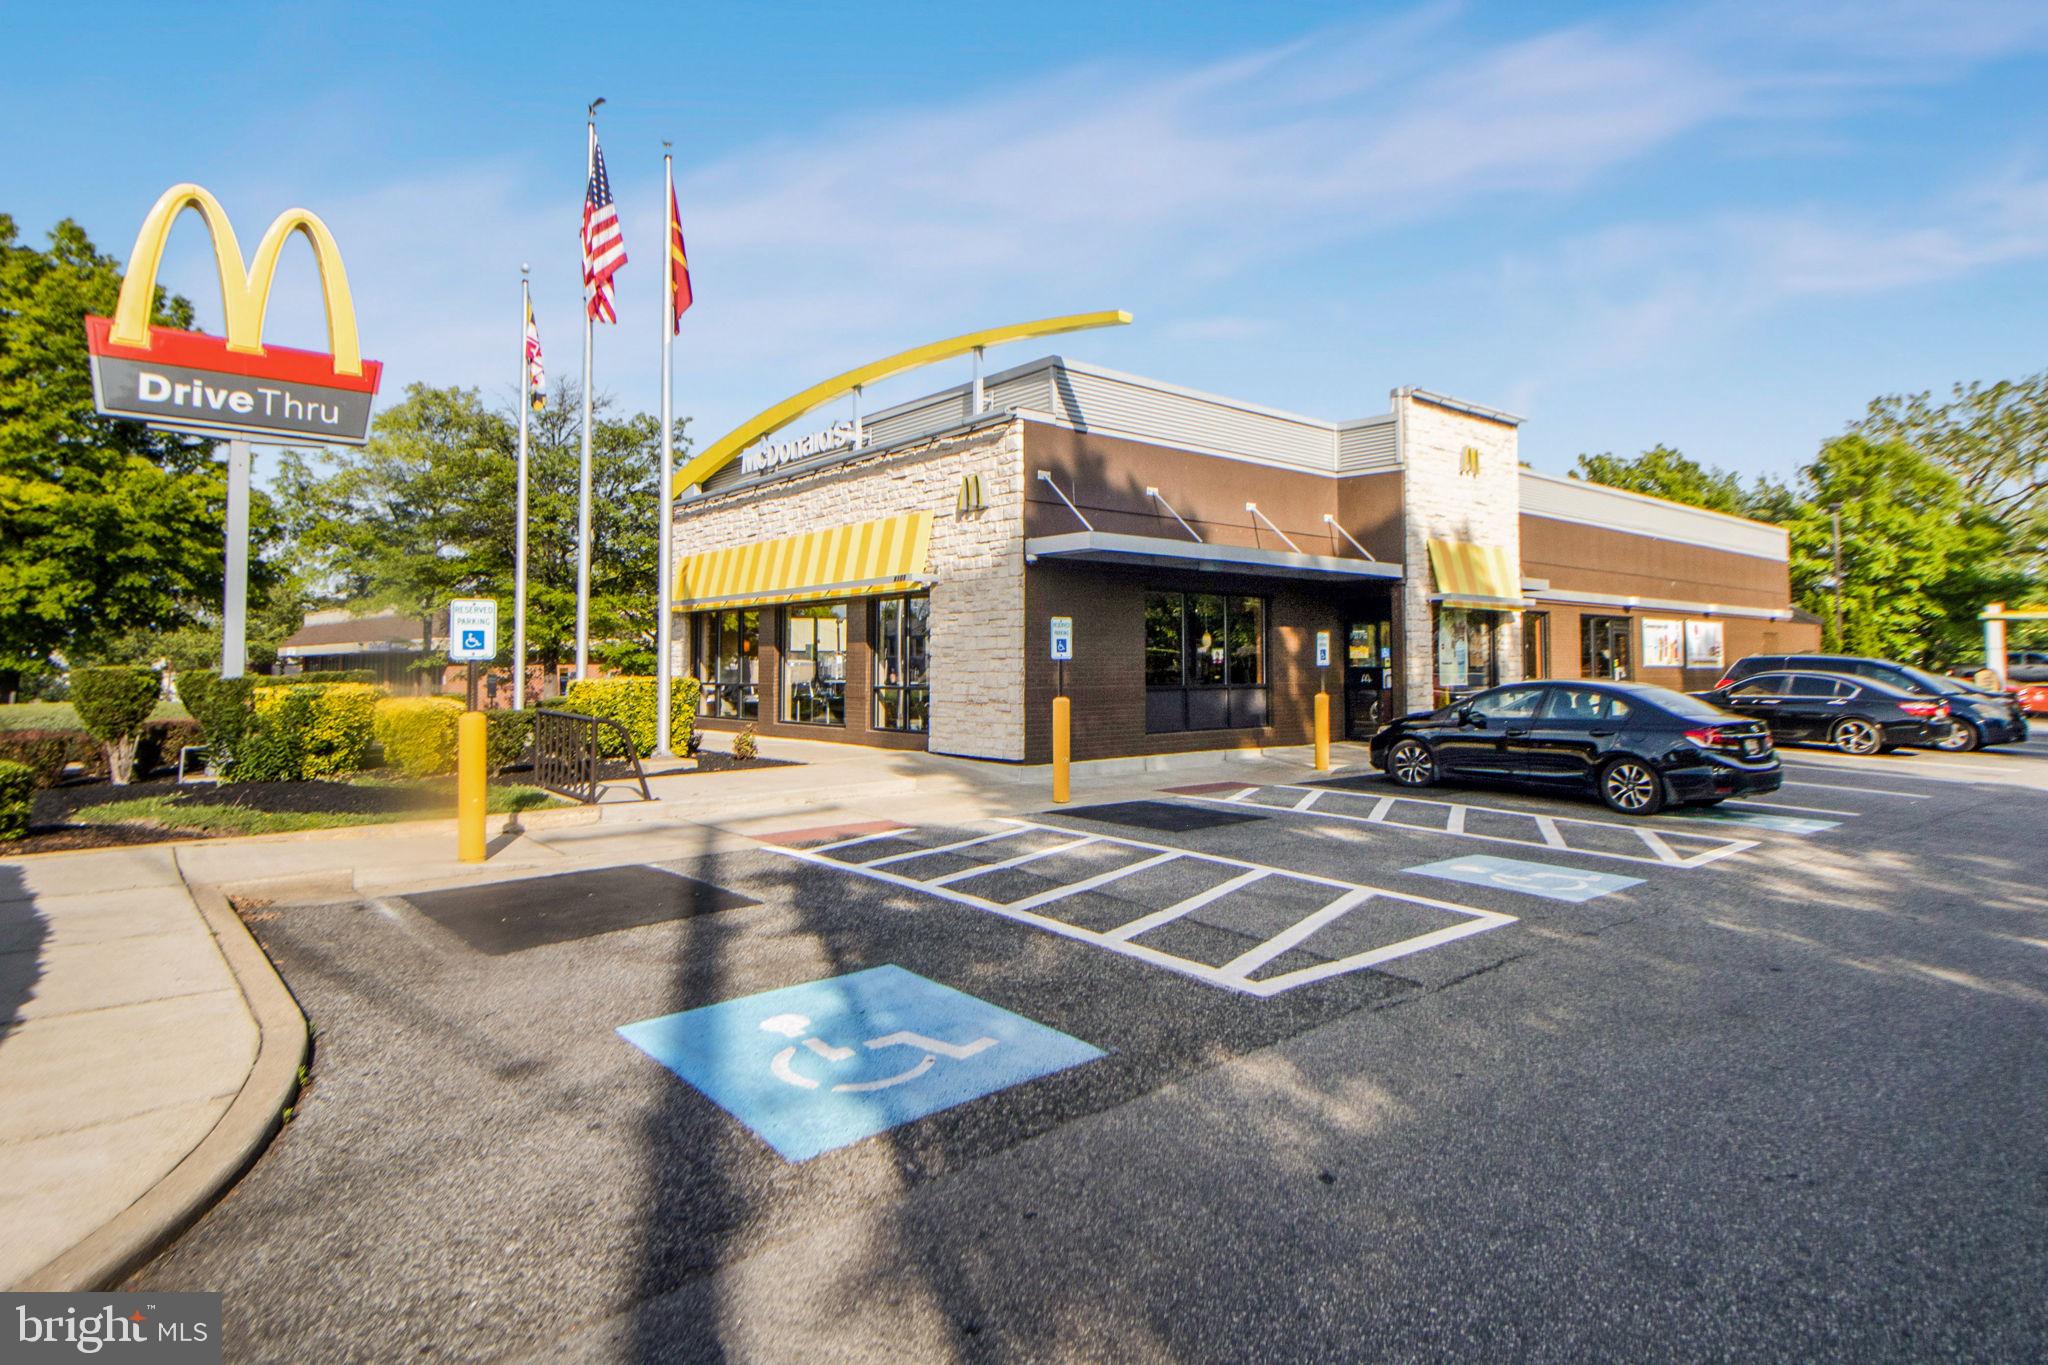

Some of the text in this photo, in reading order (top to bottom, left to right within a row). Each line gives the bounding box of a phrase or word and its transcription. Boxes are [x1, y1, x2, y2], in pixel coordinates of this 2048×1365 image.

[138, 372, 339, 425] Drive Thru
[454, 606, 494, 614] RESERVED
